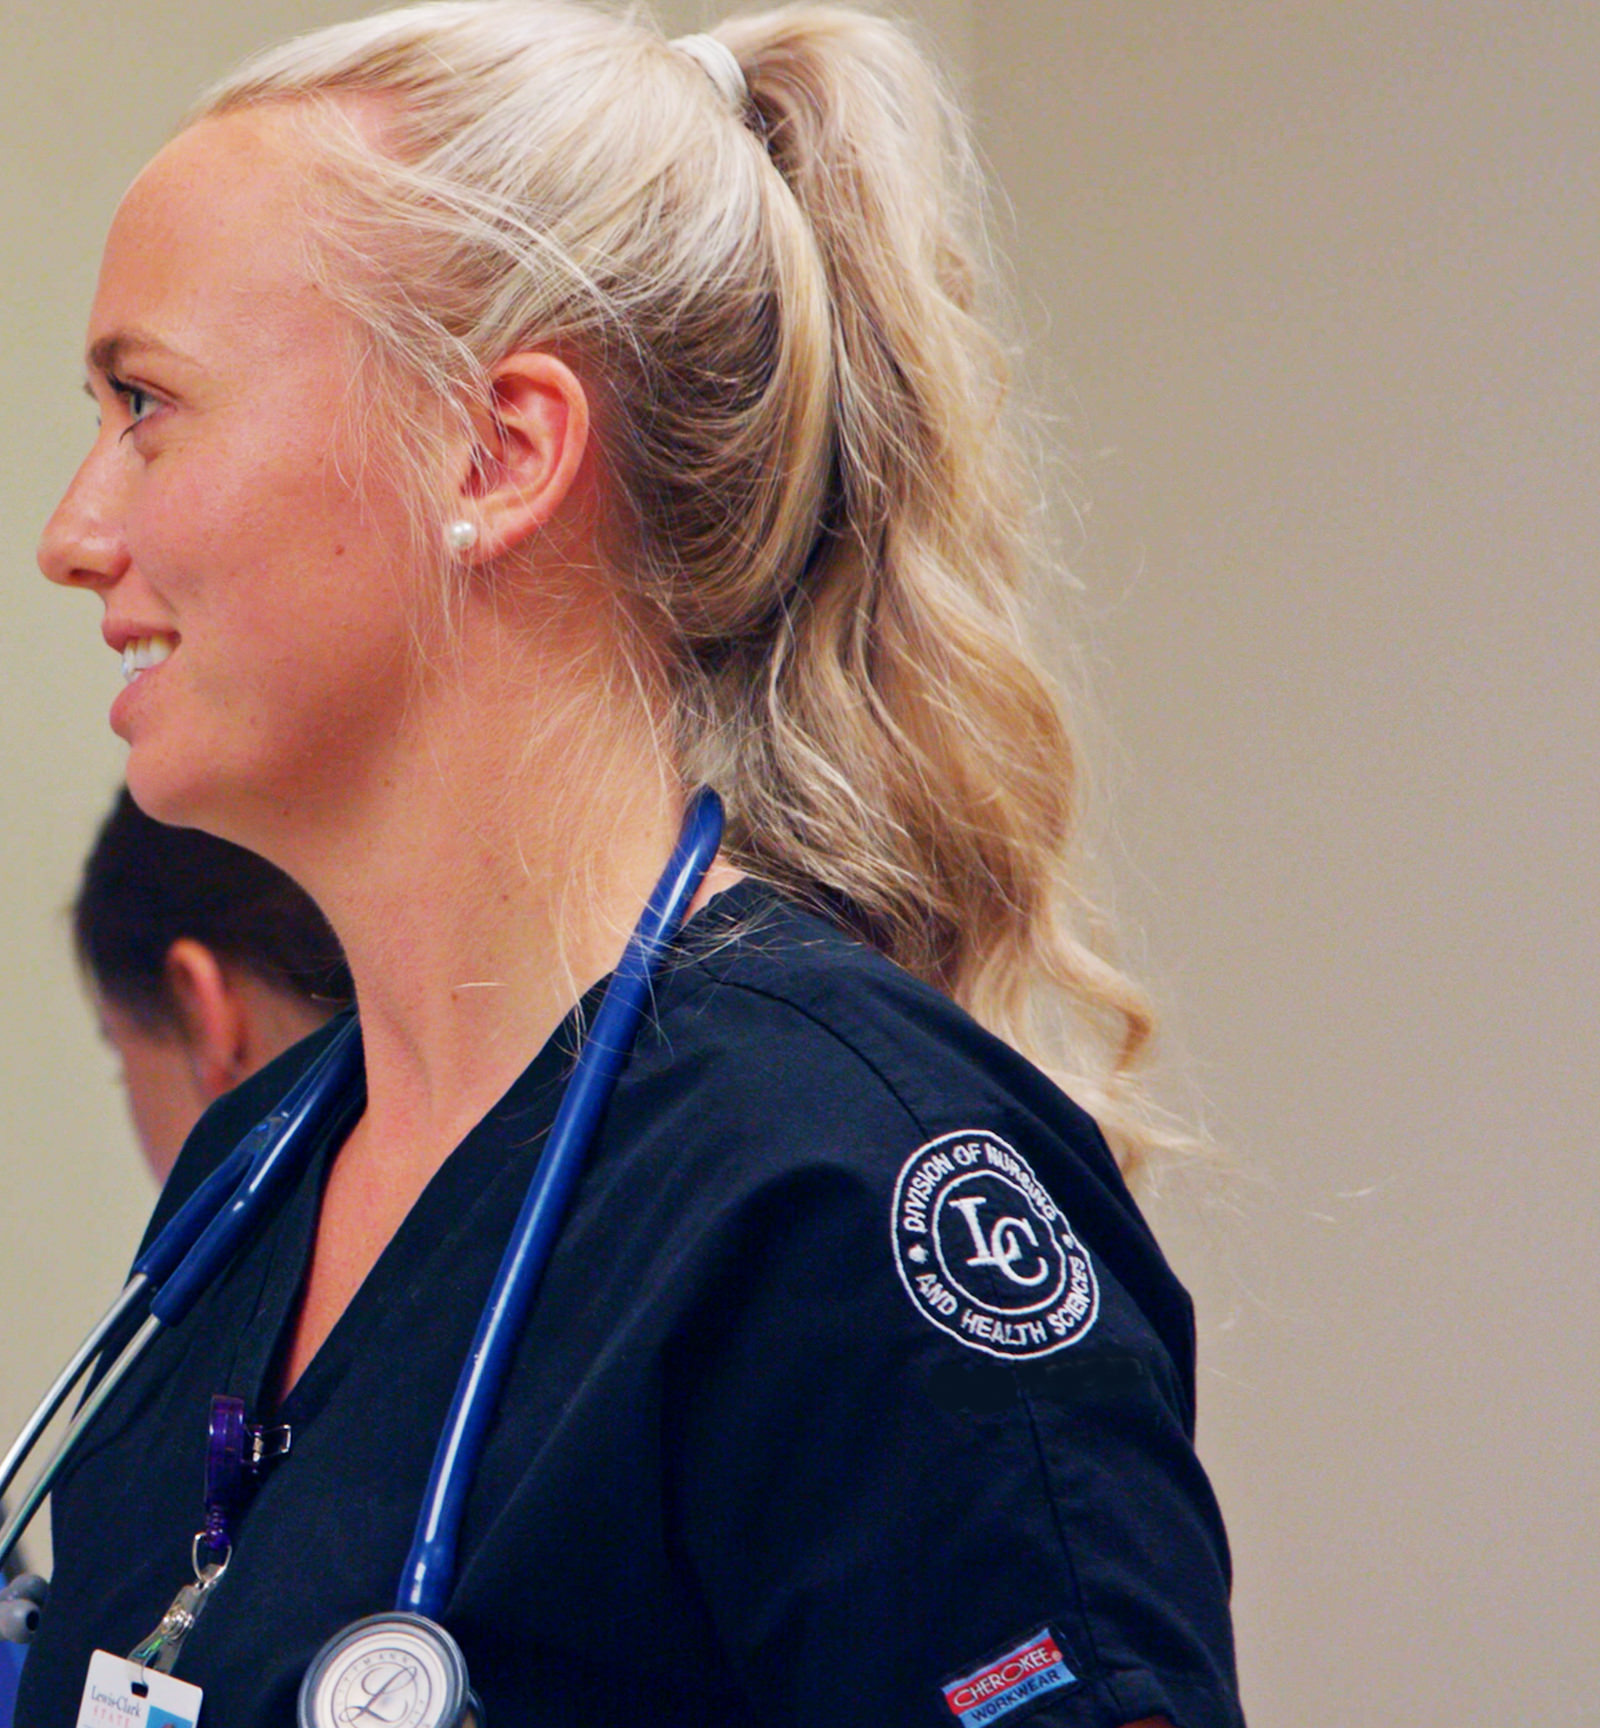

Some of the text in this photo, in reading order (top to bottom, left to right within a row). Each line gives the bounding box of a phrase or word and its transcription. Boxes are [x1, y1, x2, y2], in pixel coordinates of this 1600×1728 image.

[903, 1142, 1057, 1234] DIVISION OF NURSING
[948, 1196, 1048, 1286] LC
[915, 1255, 1091, 1345] AND HEALTH SCIENCES
[954, 1647, 1052, 1707] CHEROKEE
[970, 1669, 1061, 1722] WORKWEAR
